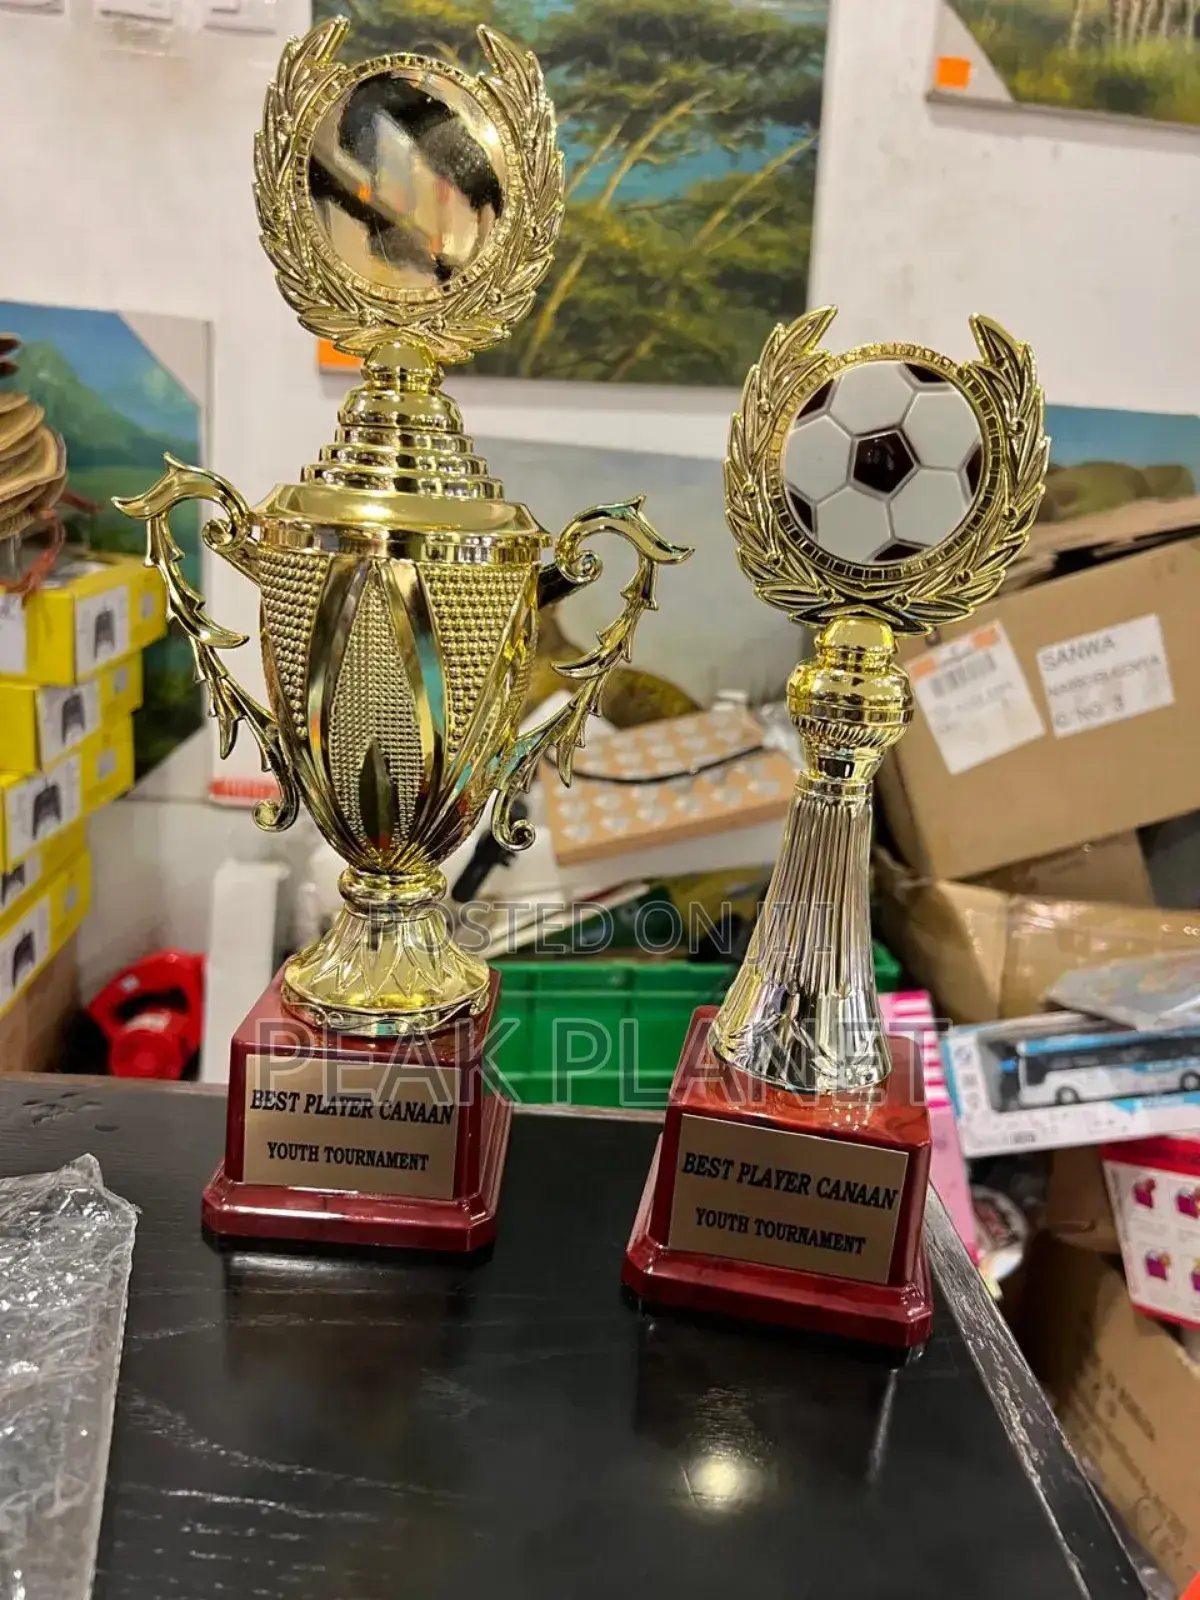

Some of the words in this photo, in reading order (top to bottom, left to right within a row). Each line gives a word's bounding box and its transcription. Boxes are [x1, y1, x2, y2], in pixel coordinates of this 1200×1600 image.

[1042, 635, 1115, 673] SANWA
[250, 1089, 300, 1112] BEST
[303, 1094, 374, 1119] PLAYER
[379, 1100, 454, 1125] CANAAN
[267, 1141, 319, 1162] YOUTH
[324, 1146, 429, 1171] TOURNAMENT
[682, 1152, 734, 1180] BEST
[736, 1162, 812, 1195] PLAYER
[816, 1177, 898, 1210] CANAAN
[695, 1207, 750, 1235] YOUTH
[754, 1218, 866, 1255] TOURNAMENT
